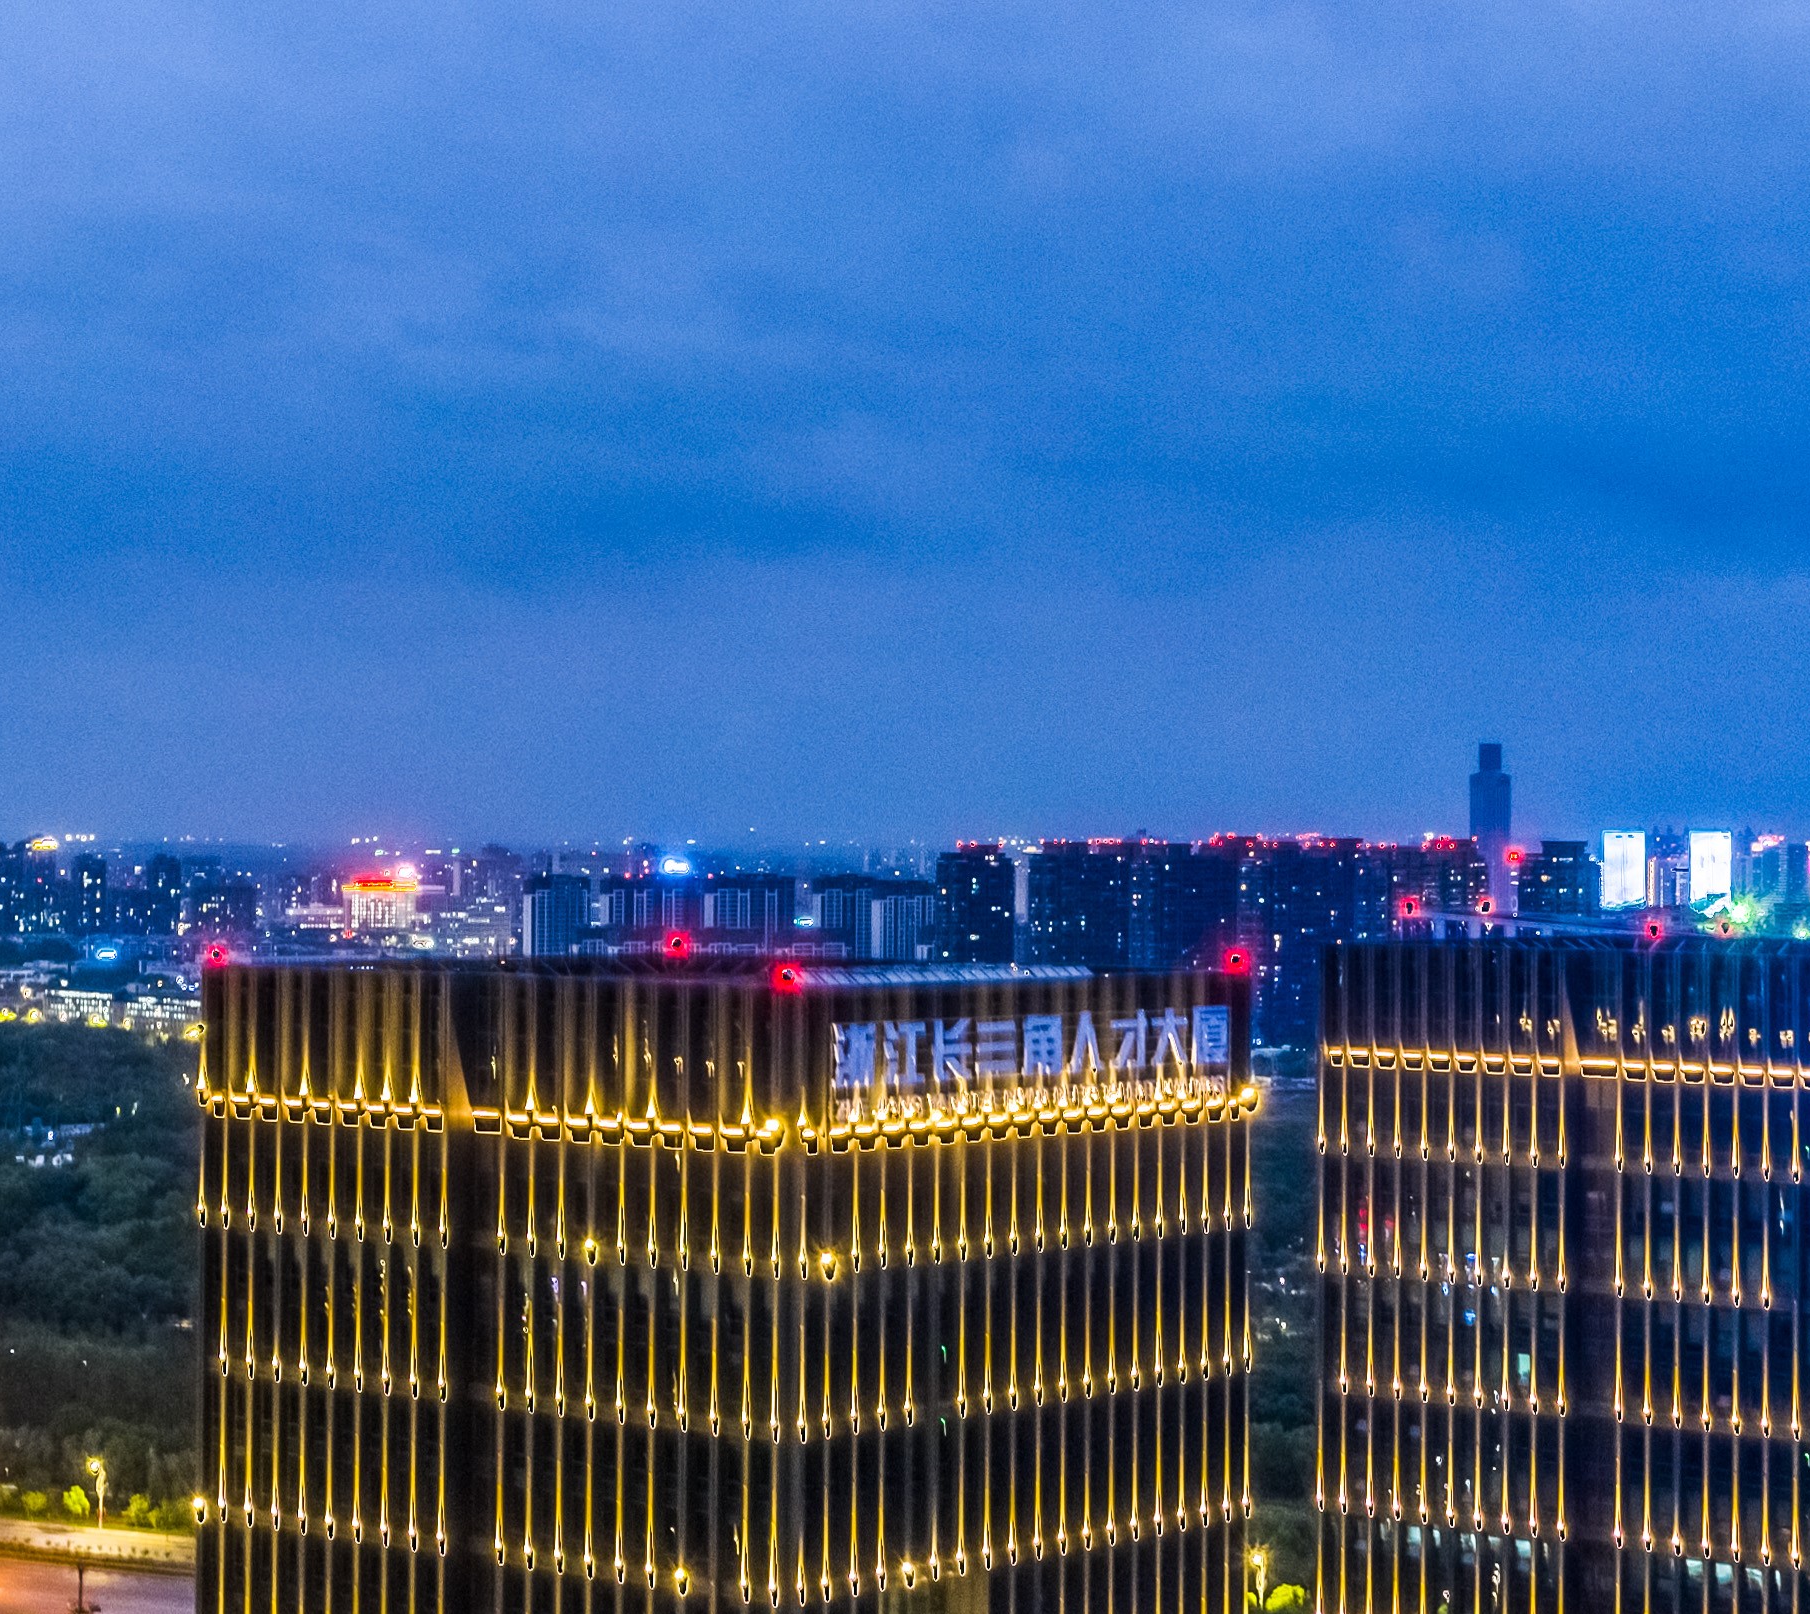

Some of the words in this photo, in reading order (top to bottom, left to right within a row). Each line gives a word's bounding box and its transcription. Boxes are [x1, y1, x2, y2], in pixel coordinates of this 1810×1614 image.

[831, 1005, 1230, 1088] 浙江长三角人才大厦
